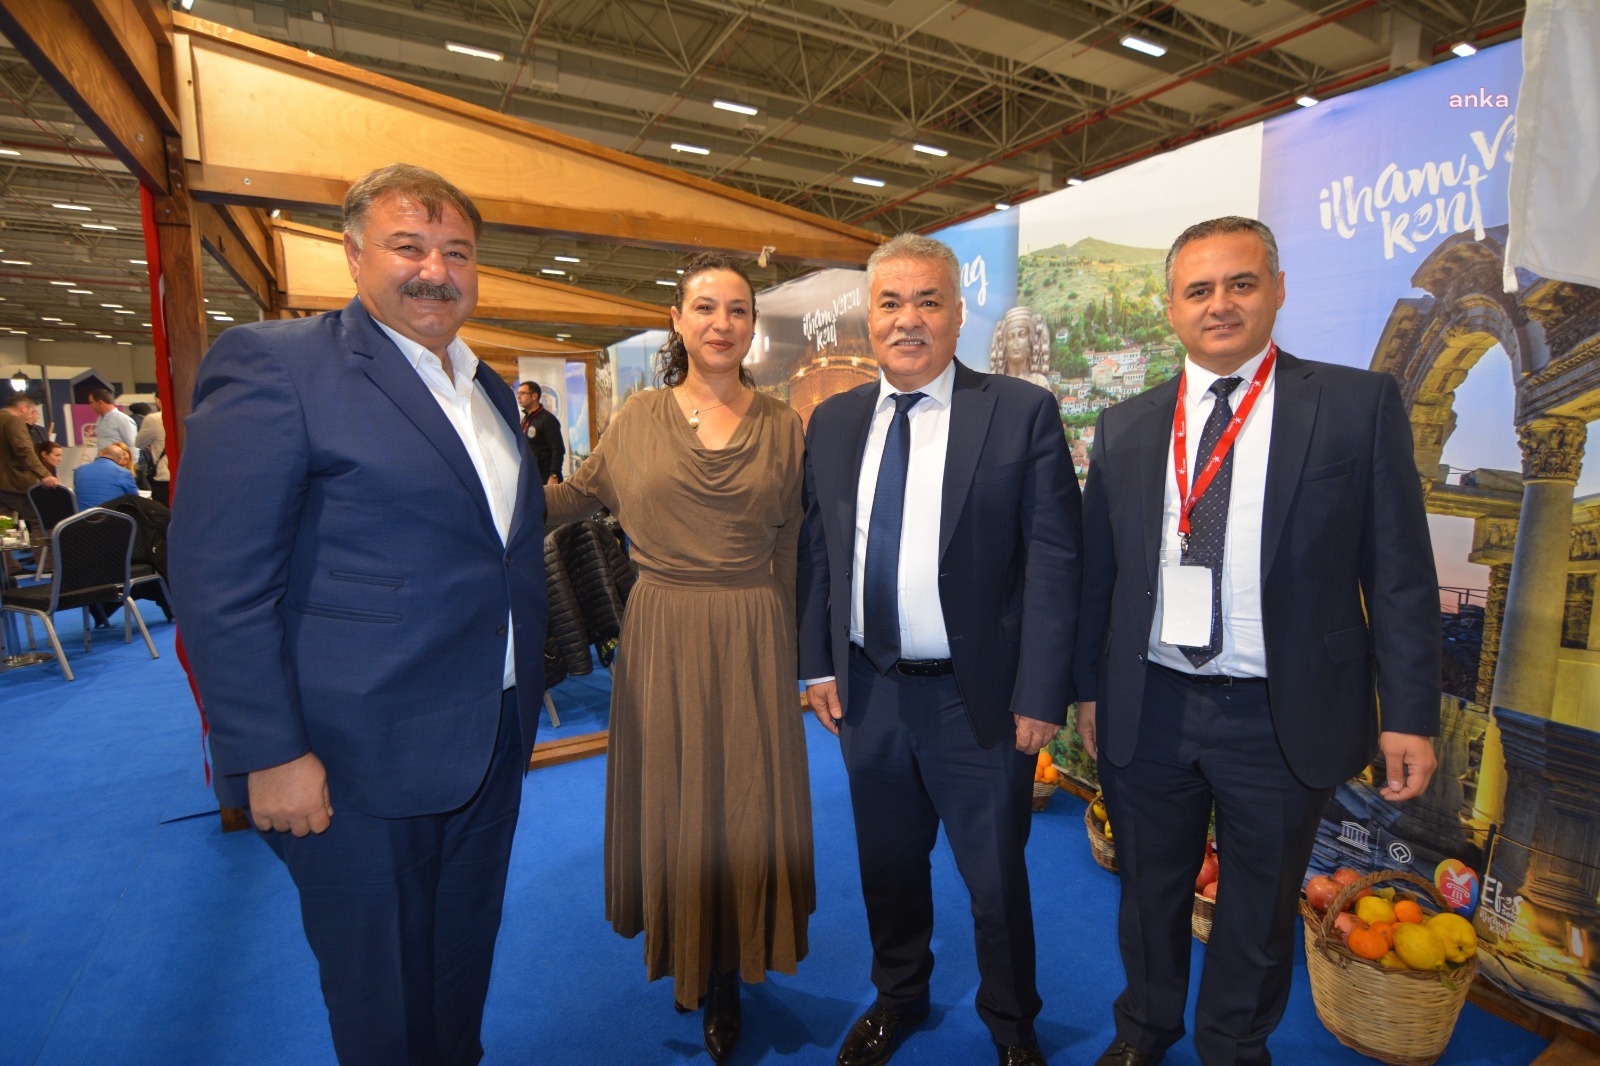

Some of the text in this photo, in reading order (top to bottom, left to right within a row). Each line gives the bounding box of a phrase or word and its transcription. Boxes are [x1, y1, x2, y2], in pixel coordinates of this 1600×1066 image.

[1319, 153, 1468, 240] ilham
[1380, 164, 1488, 260] kent
[803, 308, 834, 342] ilham
[1480, 873, 1524, 914] Efes
